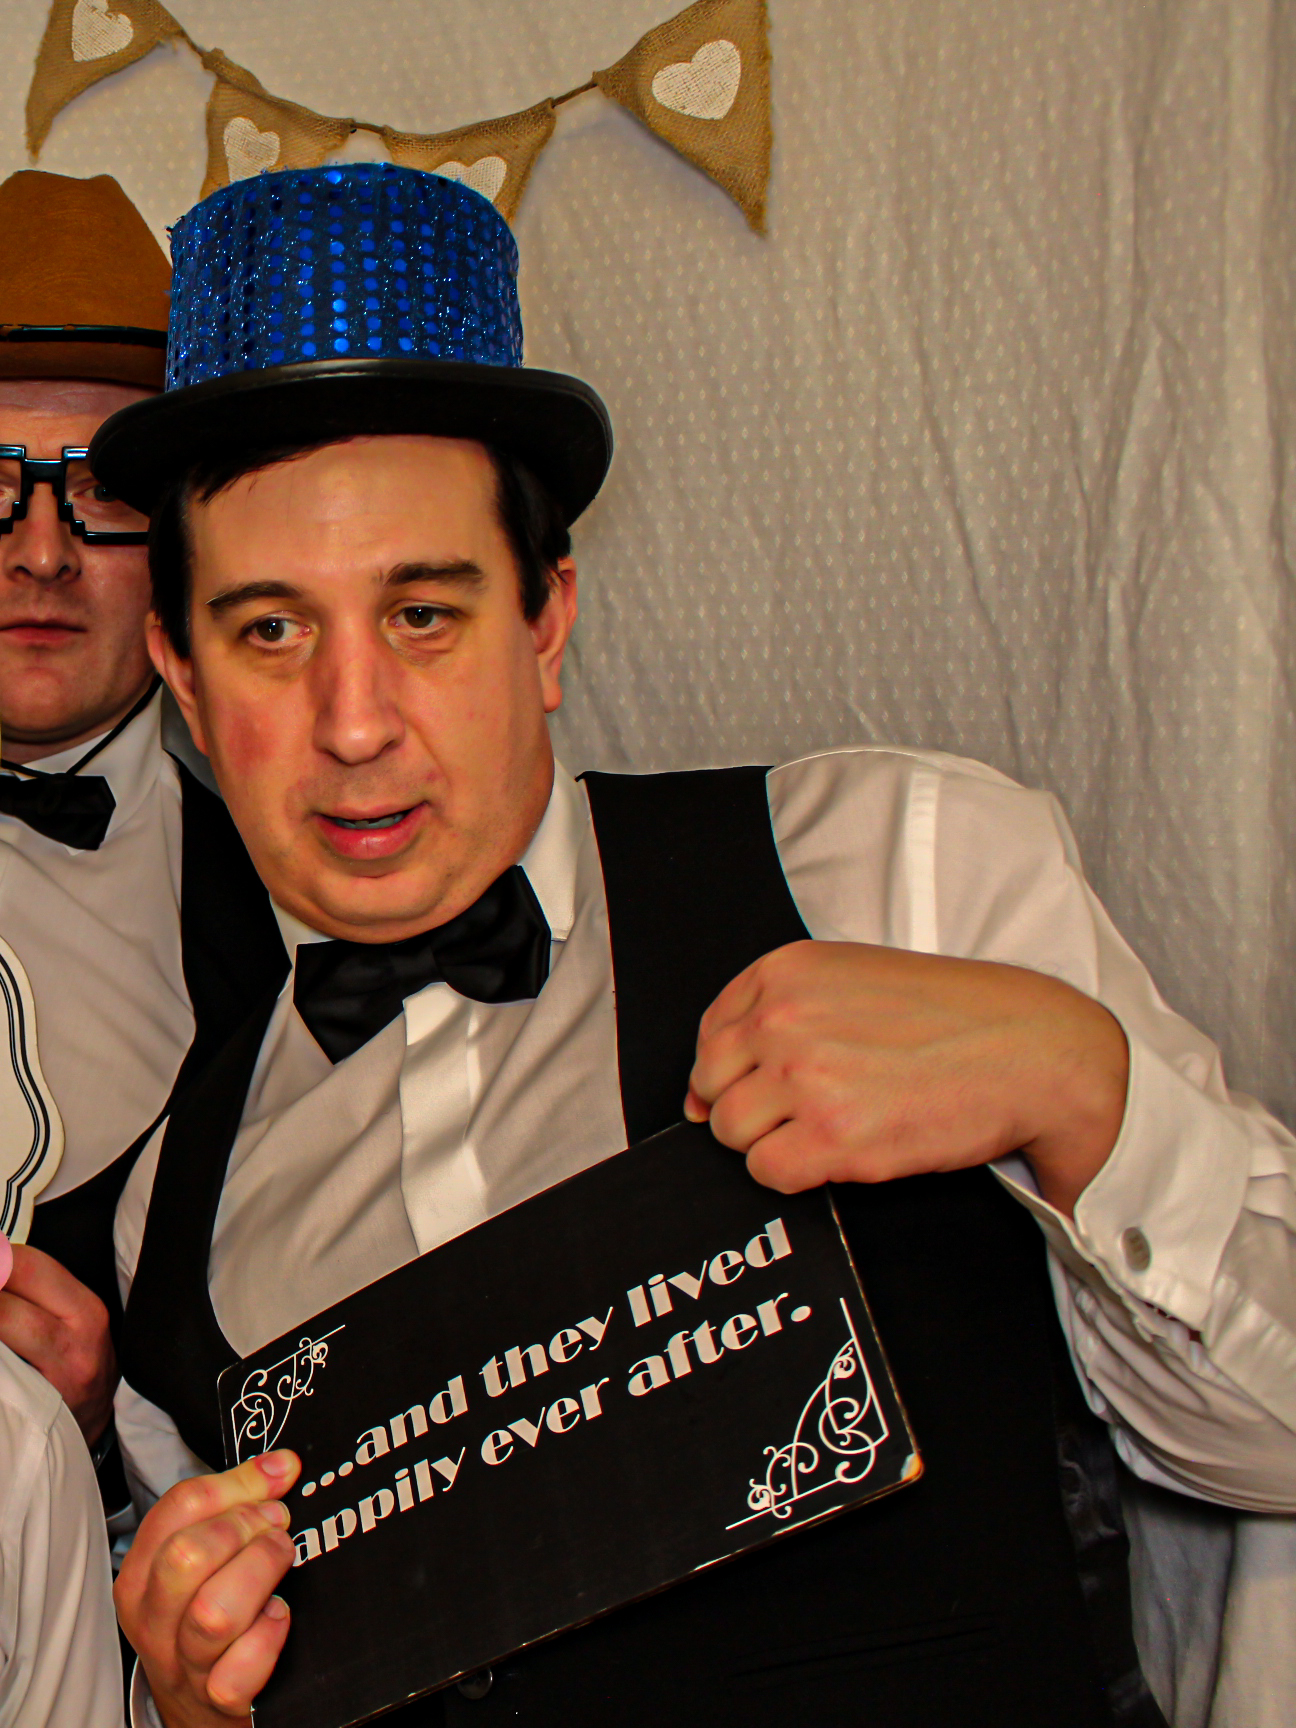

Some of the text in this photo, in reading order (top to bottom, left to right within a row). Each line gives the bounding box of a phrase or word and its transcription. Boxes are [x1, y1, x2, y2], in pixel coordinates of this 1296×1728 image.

[291, 1292, 811, 1567] appily ever after.
[301, 1217, 792, 1496] ...and they lived
